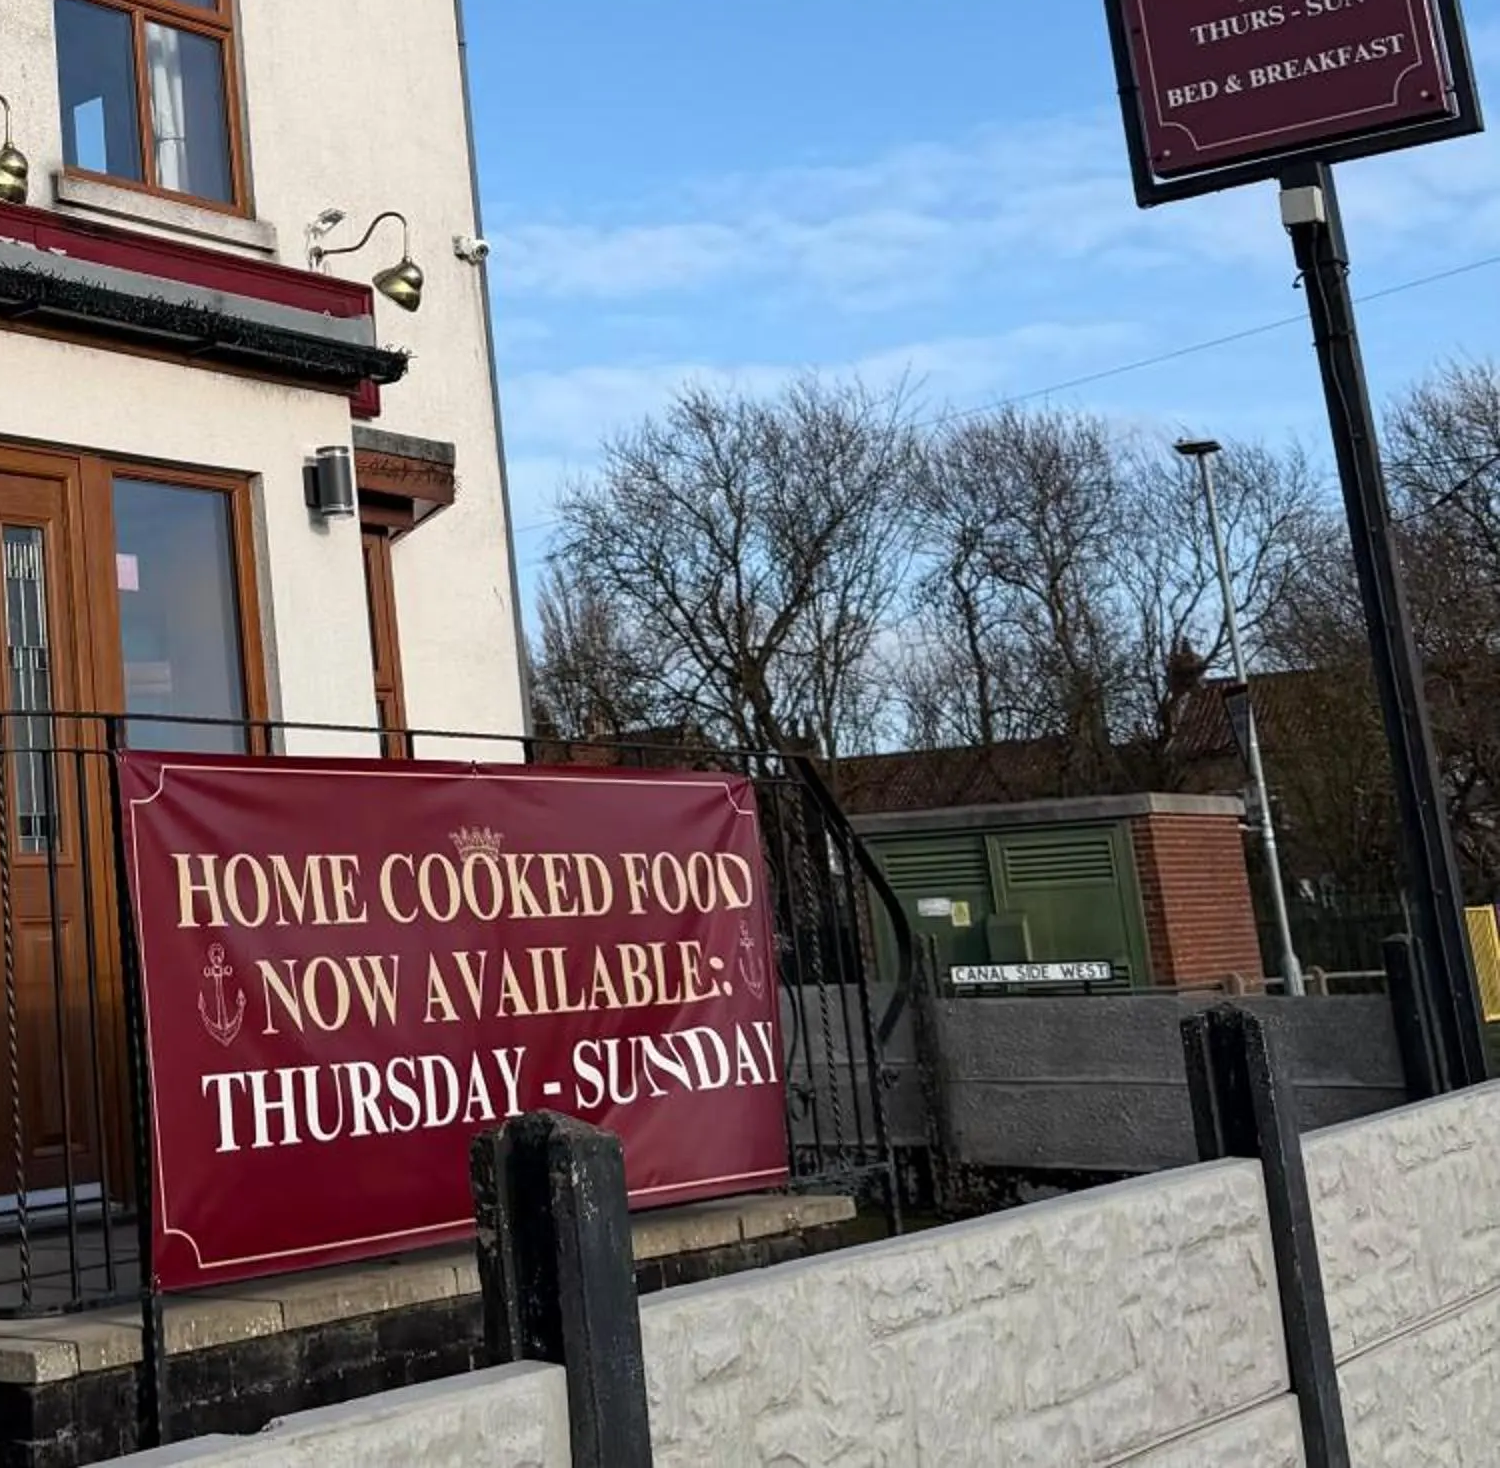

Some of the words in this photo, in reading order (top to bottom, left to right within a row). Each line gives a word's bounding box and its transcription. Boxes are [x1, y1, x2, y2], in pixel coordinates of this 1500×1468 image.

[1189, 4, 1285, 46] THURS
[1166, 81, 1219, 109] BED
[1224, 73, 1243, 94] &
[1249, 33, 1405, 89] BREAKFAST
[171, 852, 368, 929] HOME
[379, 851, 614, 923] COOKED
[619, 850, 753, 917] FOOD
[254, 952, 400, 1036] NOW
[423, 940, 735, 1024] AVAILABLE:
[955, 966, 1009, 981] CANAL
[1016, 965, 1049, 980] SIDE
[1060, 964, 1108, 980] WEST
[201, 1046, 527, 1153] THURSDAY
[542, 1081, 561, 1095] -
[572, 1020, 780, 1111] SUNDAY
